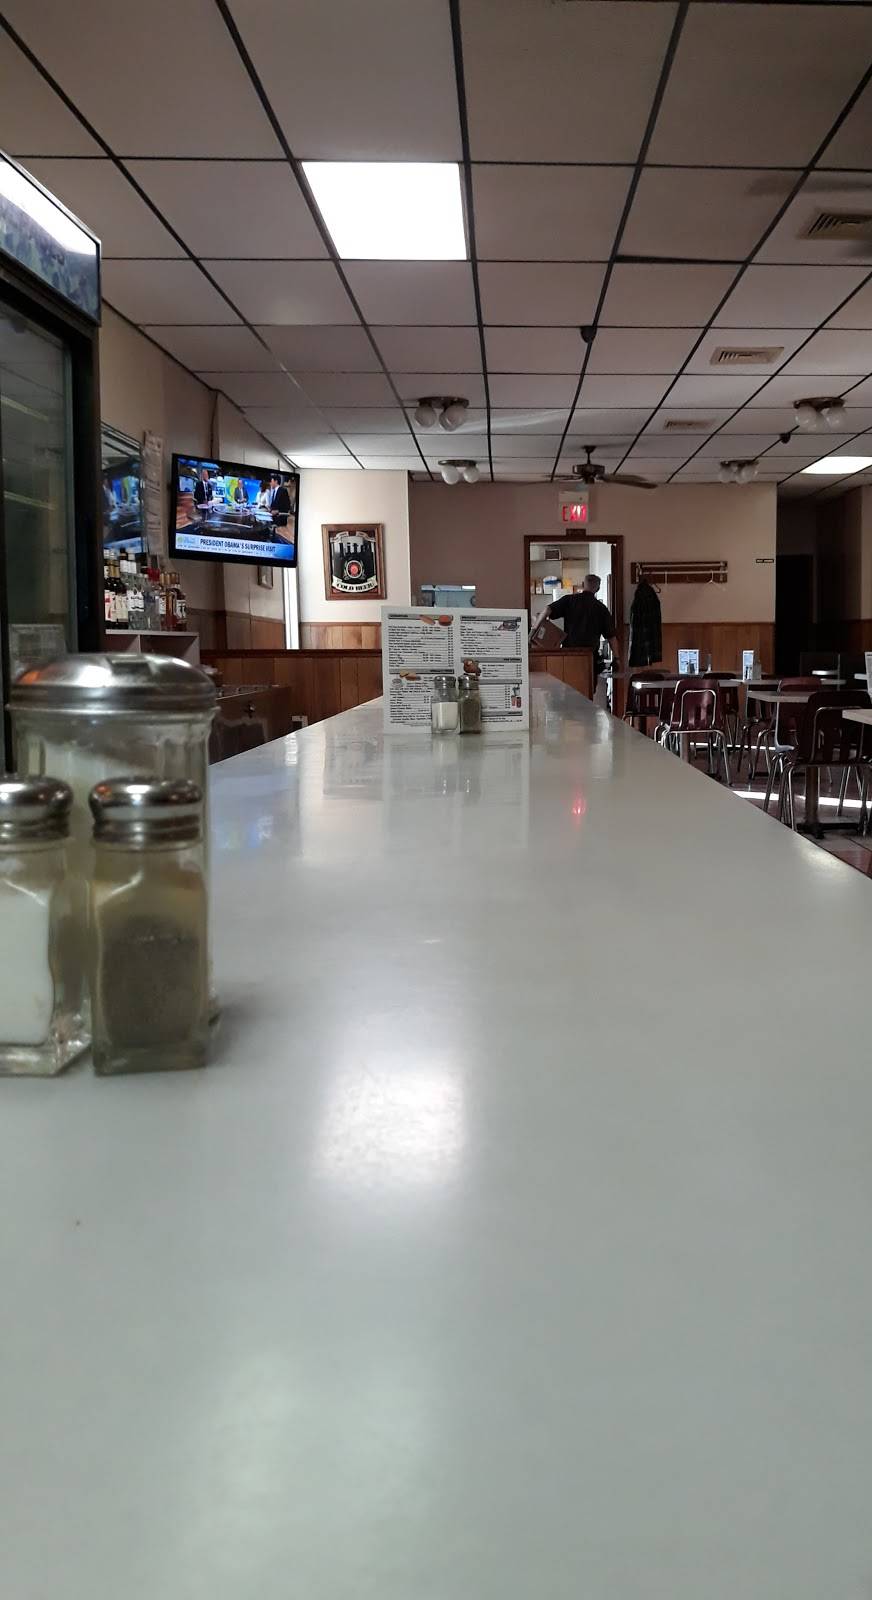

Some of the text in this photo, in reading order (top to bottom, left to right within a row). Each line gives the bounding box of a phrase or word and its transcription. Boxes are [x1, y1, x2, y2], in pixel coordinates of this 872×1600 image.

[562, 505, 587, 522] EXIT
[200, 538, 224, 547] PRESIDENT
[224, 541, 244, 549] OBAMA'S
[337, 581, 374, 591] COLD BEER
